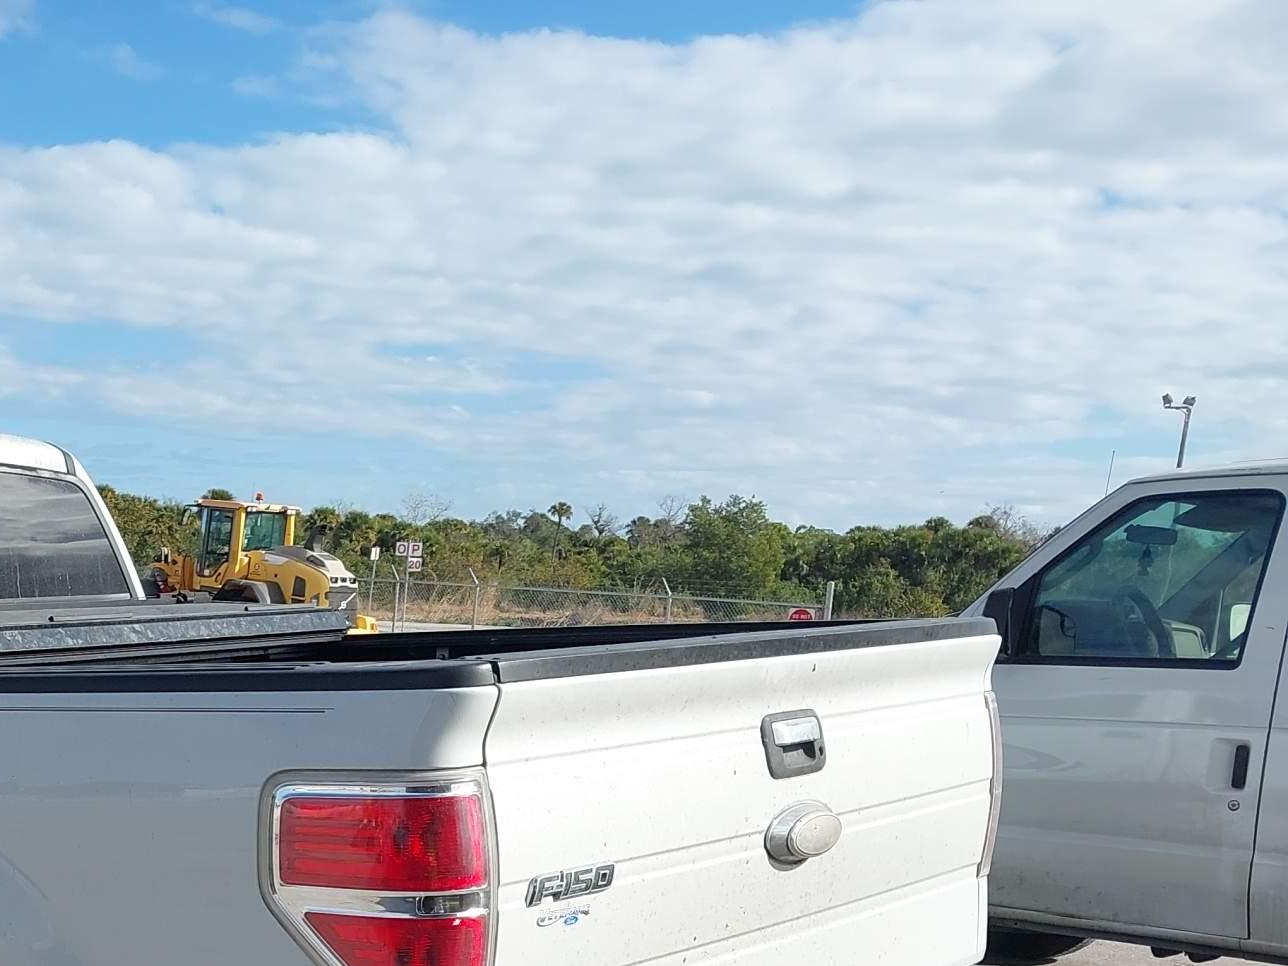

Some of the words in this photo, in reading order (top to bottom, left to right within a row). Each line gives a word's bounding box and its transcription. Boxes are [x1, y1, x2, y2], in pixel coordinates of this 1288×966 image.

[412, 544, 420, 554] P
[408, 560, 421, 569] 20
[524, 863, 615, 909] F-150
